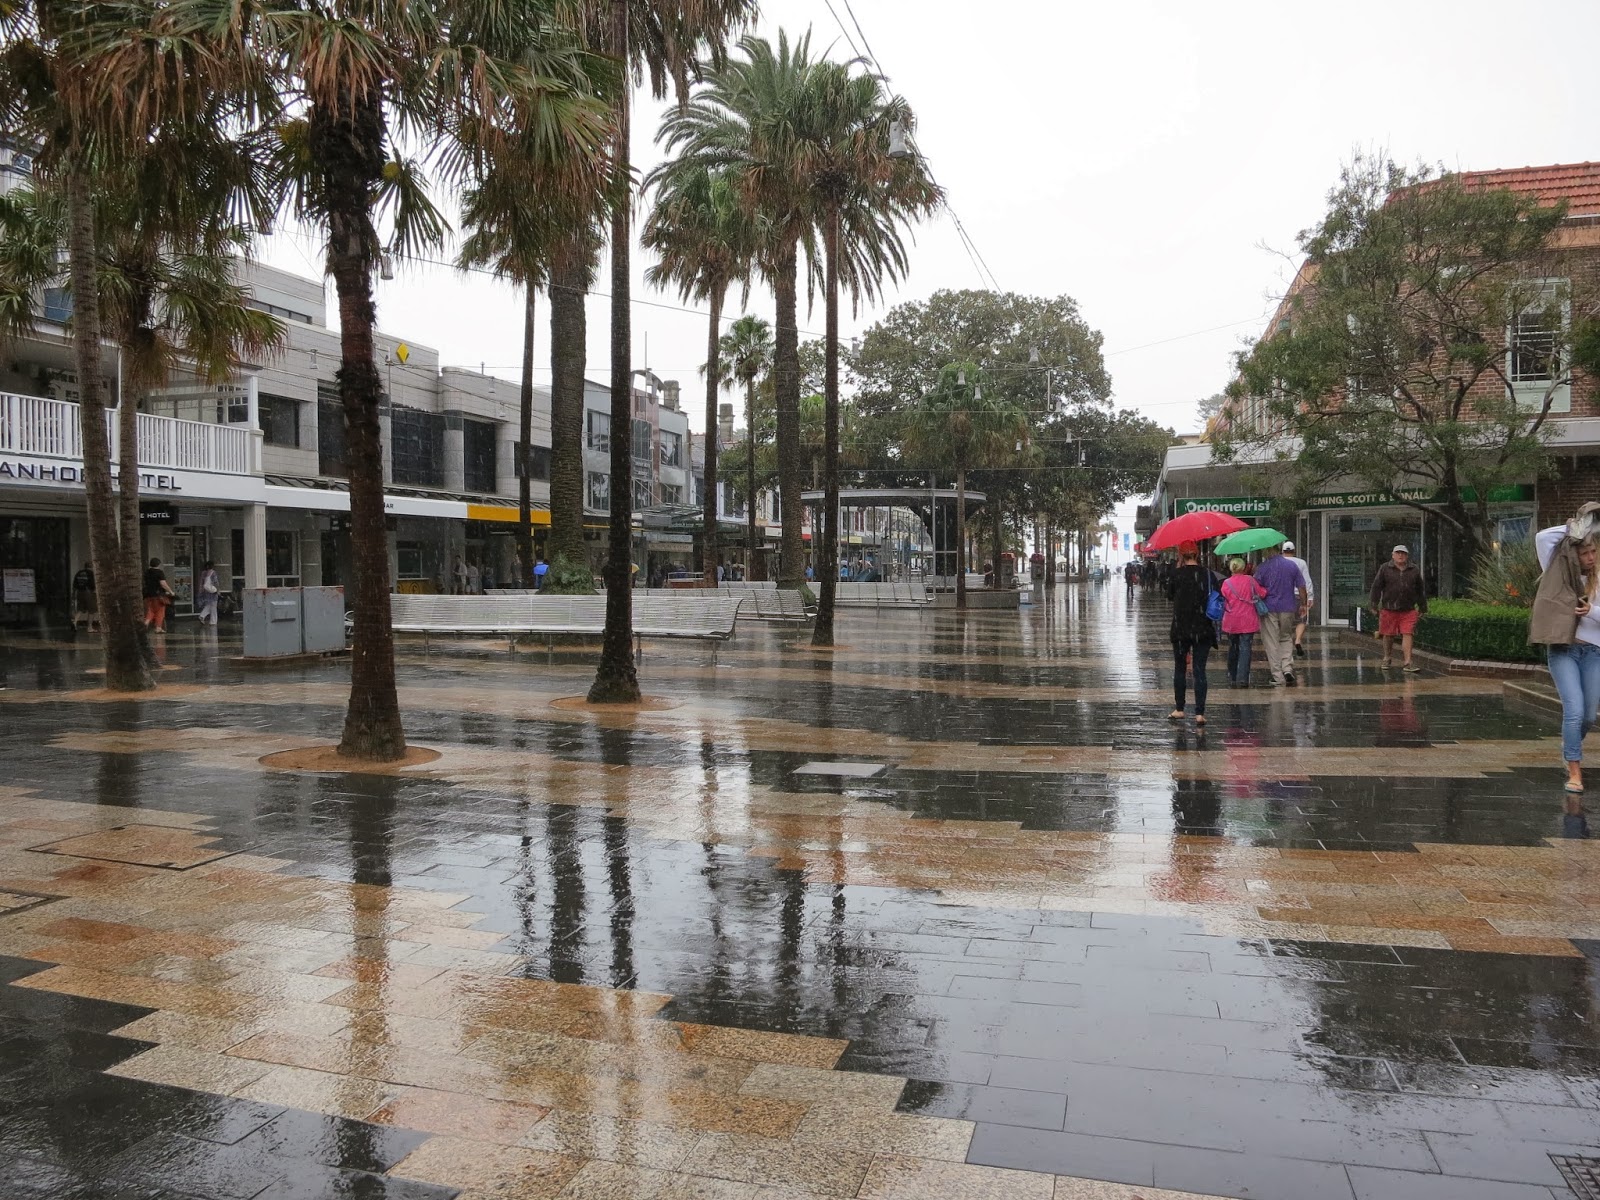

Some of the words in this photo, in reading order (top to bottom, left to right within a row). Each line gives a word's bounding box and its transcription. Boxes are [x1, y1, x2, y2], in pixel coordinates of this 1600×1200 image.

[1347, 494, 1376, 504] SCOTT
[1379, 493, 1386, 502] &
[1186, 500, 1270, 513] Optometrist
